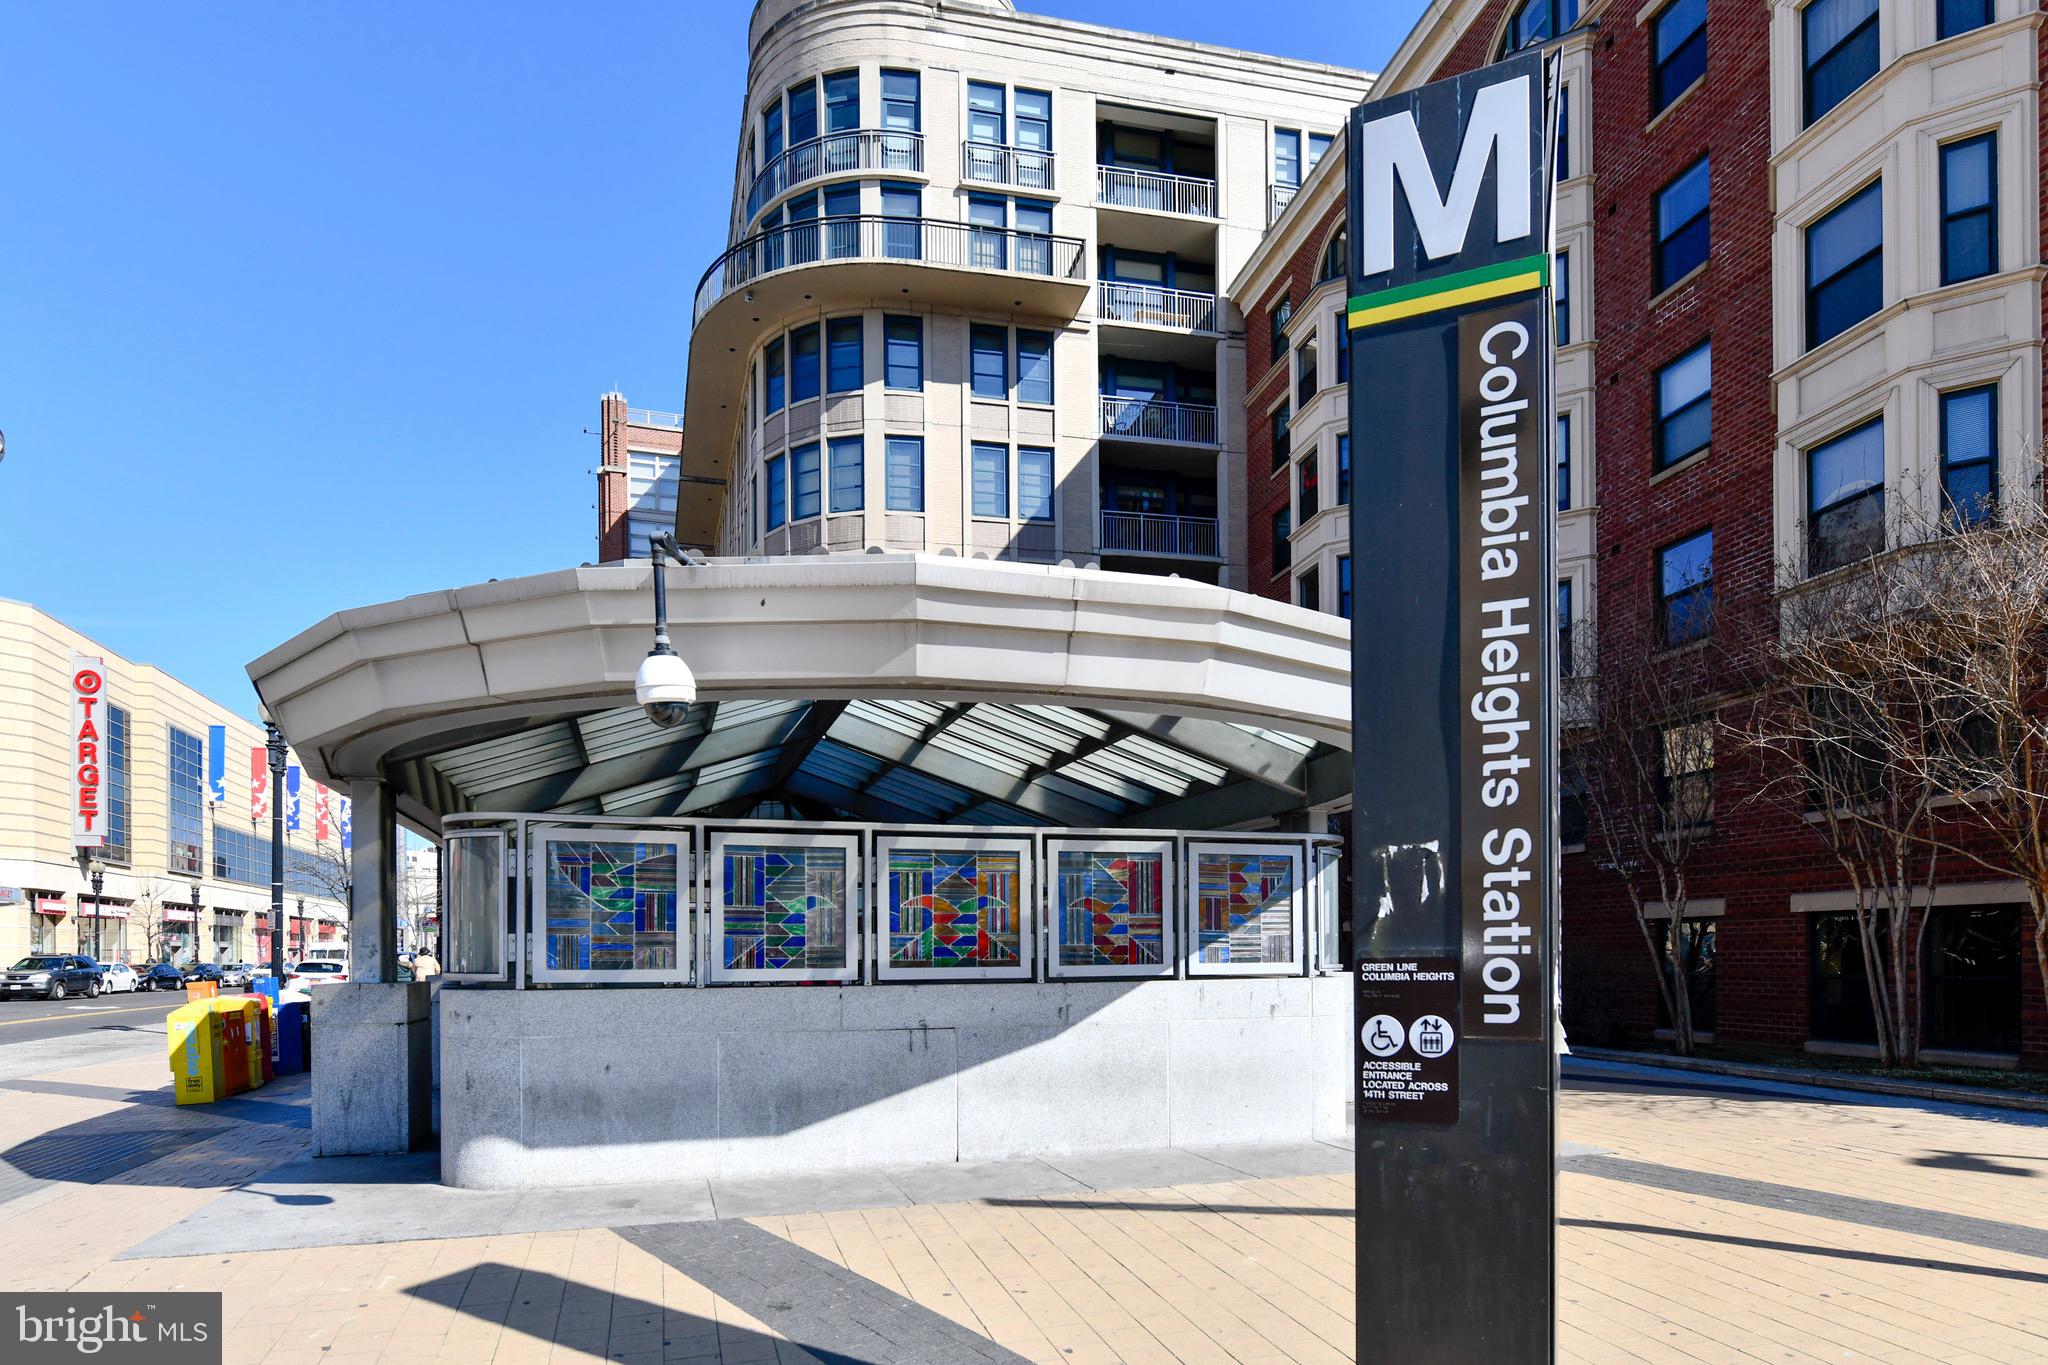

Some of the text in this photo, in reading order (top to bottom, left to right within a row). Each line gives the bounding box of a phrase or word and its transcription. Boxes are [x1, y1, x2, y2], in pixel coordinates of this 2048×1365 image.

[1363, 74, 1531, 277] M
[1471, 320, 1533, 1025] Columbia Heights Station
[77, 697, 99, 832] TARGET
[1361, 962, 1418, 972] GREEN LINE
[1361, 972, 1455, 981] COLUMBIA HEIGHTS
[1363, 1061, 1422, 1071] ACCESSIBLE
[1362, 1071, 1413, 1081] ENTRANCE
[1362, 1080, 1449, 1092] LOCATED ACROSS
[1363, 1090, 1425, 1101] 14TH STREET
